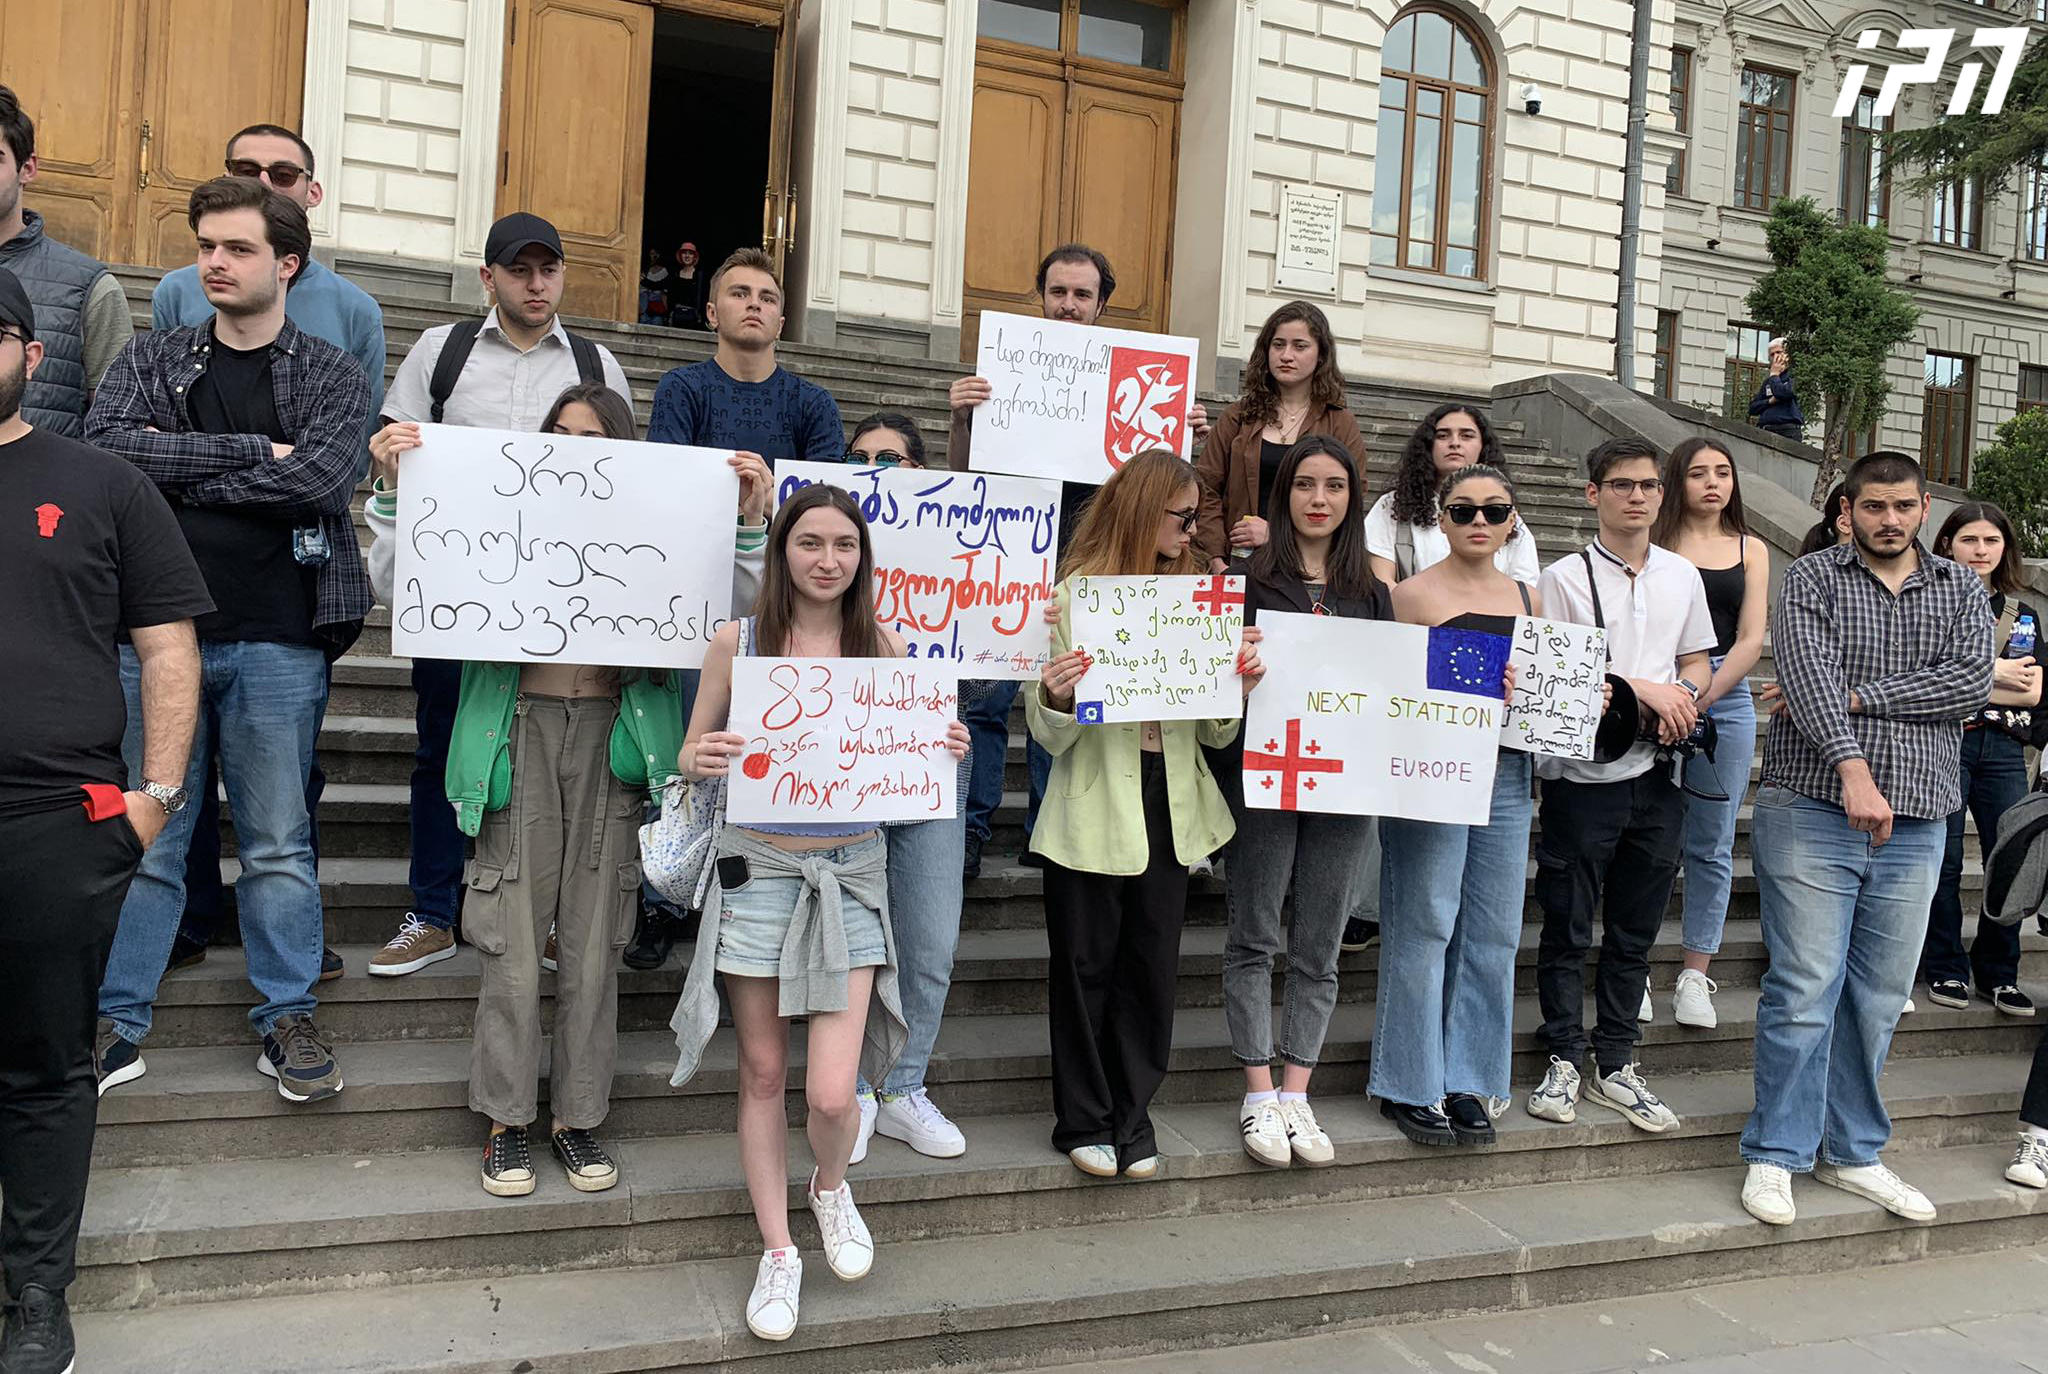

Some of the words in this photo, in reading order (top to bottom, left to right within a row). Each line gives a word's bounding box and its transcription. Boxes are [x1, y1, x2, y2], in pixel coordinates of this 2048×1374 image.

[991, 383, 1087, 430] ევროპაში!
[493, 442, 614, 501] არა
[412, 497, 667, 588] რუსულ
[399, 577, 726, 657] მთავრობას
[1078, 577, 1099, 613] მე
[1112, 577, 1159, 615] ვარ
[1148, 601, 1241, 647] ქართველი
[1515, 621, 1539, 655] მე
[1548, 627, 1570, 657] და
[1179, 649, 1197, 675] მე
[1205, 652, 1233, 676] ვარ
[761, 664, 833, 731] 83
[1307, 691, 1368, 714] NEXT
[1387, 697, 1491, 729] STATION
[851, 769, 942, 812] კობახიძე
[1390, 757, 1472, 782] EUROPE
